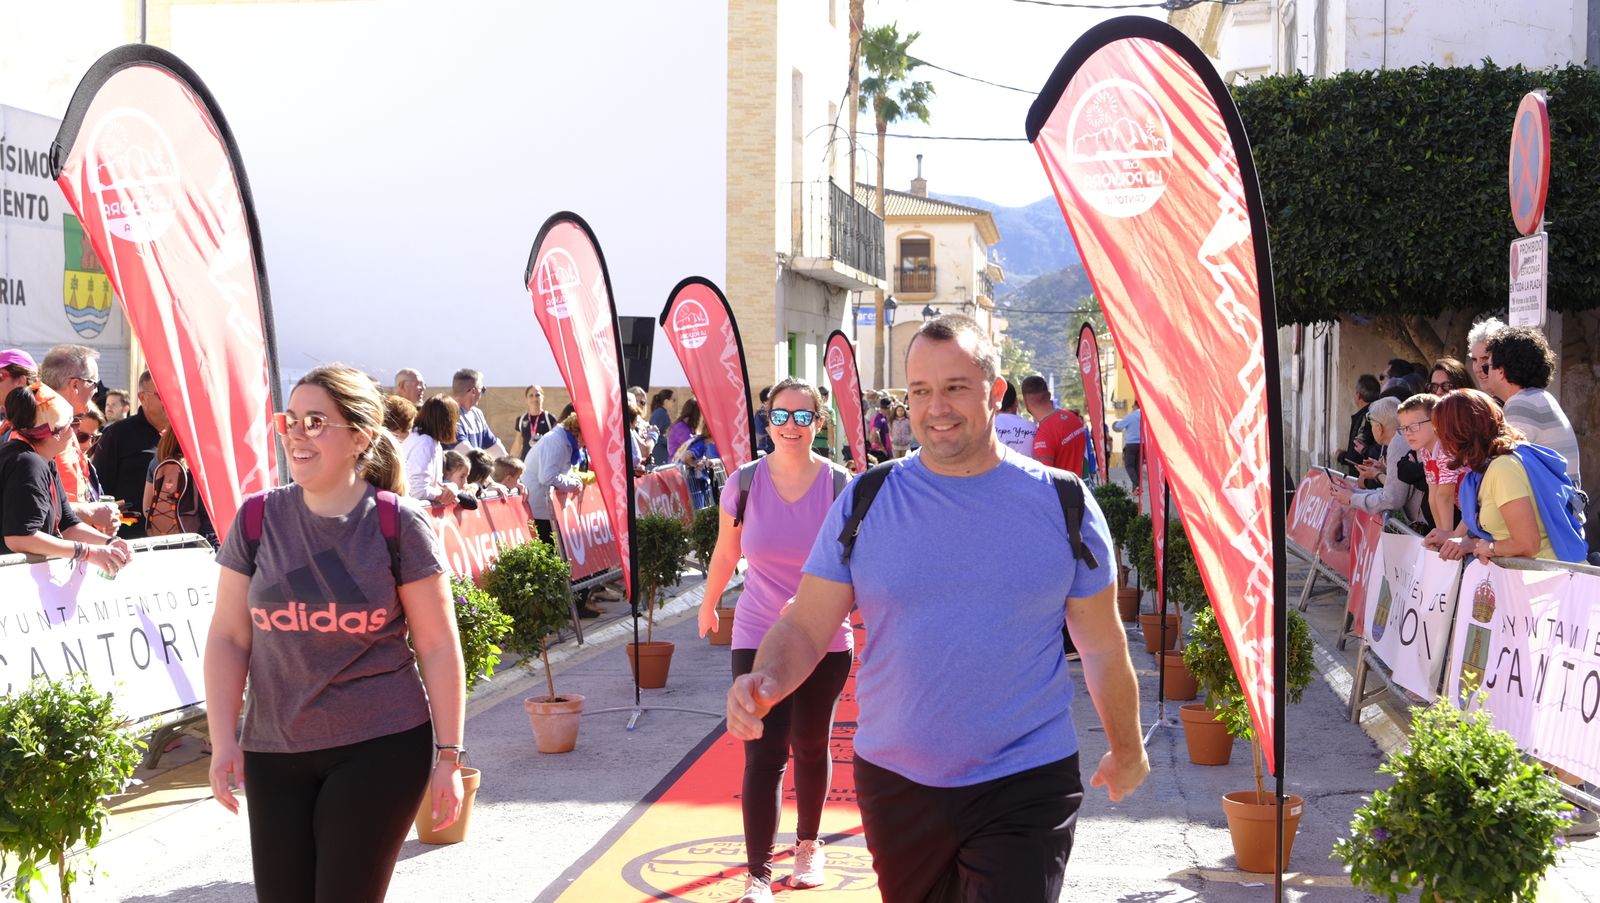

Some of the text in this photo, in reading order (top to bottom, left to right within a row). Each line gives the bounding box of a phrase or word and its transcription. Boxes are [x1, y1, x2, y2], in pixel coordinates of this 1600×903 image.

[0, 278, 26, 306] RIA
[187, 586, 213, 606] DE
[250, 602, 387, 634] adidas
